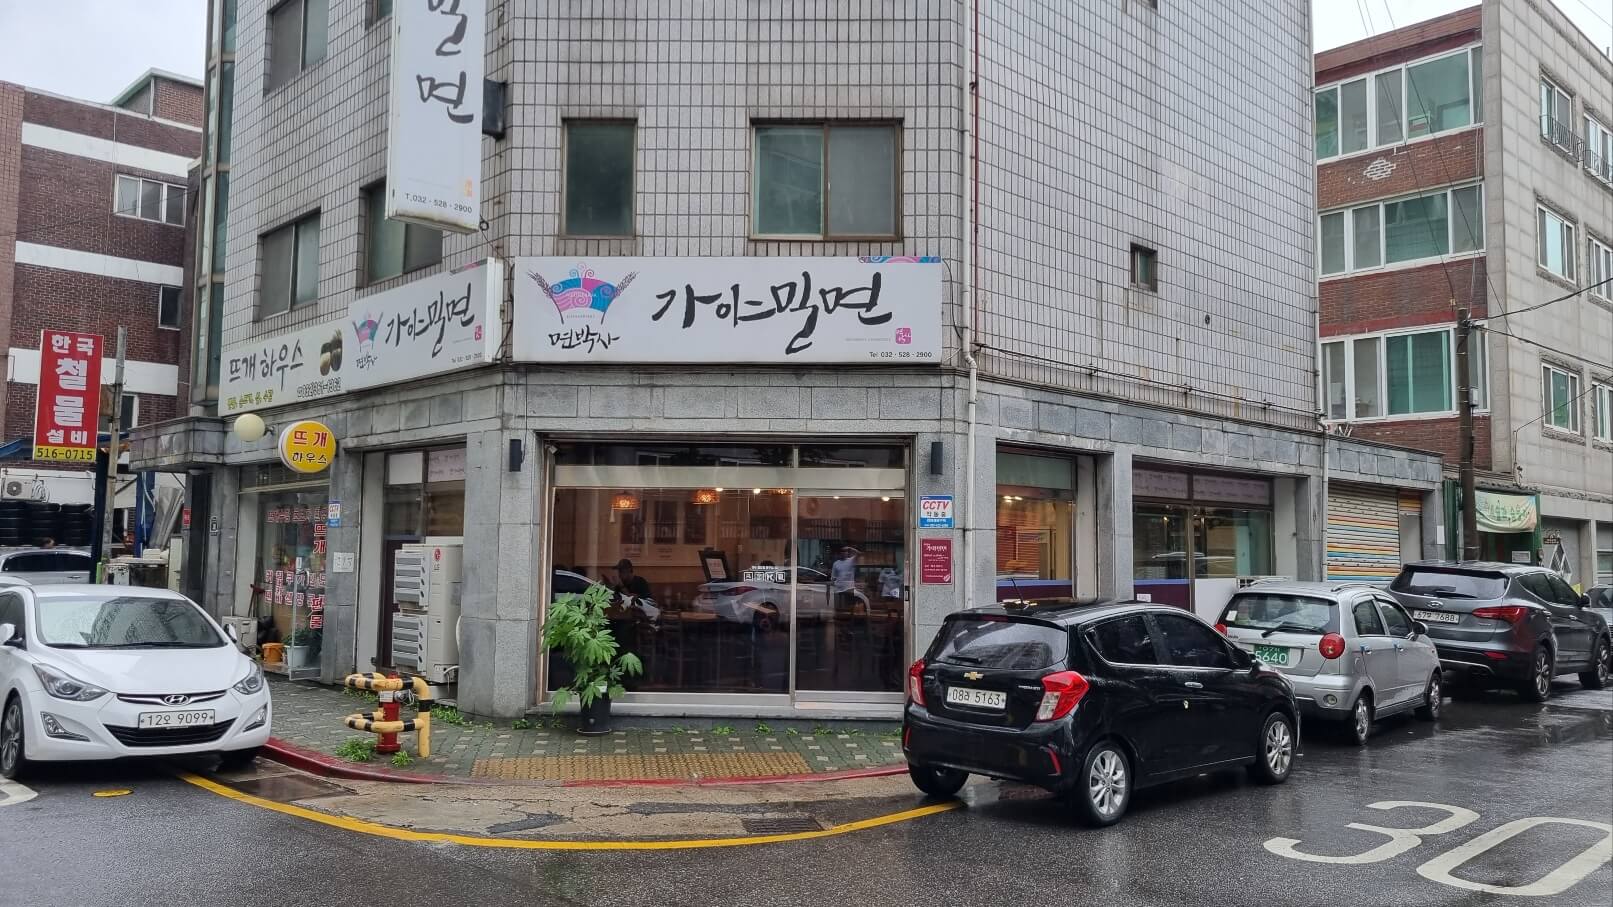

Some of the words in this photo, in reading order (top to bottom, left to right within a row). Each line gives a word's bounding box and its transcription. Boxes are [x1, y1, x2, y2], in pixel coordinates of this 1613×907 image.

[385, 283, 475, 359] 가야밀면
[651, 271, 893, 355] 가야밀면
[51, 334, 94, 356] 한국
[548, 324, 621, 354] 면박사
[229, 353, 257, 383] 뜨개
[261, 338, 304, 391] 하우스
[47, 429, 88, 445] 설비
[293, 430, 328, 447] 뜨개
[37, 446, 94, 460] 516-0715
[292, 452, 328, 464] 하우스
[923, 500, 949, 510] CCTV
[1255, 650, 1287, 664] 5640
[975, 691, 1001, 706] 5163
[147, 715, 171, 726] 12오
[177, 712, 208, 724] 9099
[1262, 800, 1613, 896] 30
